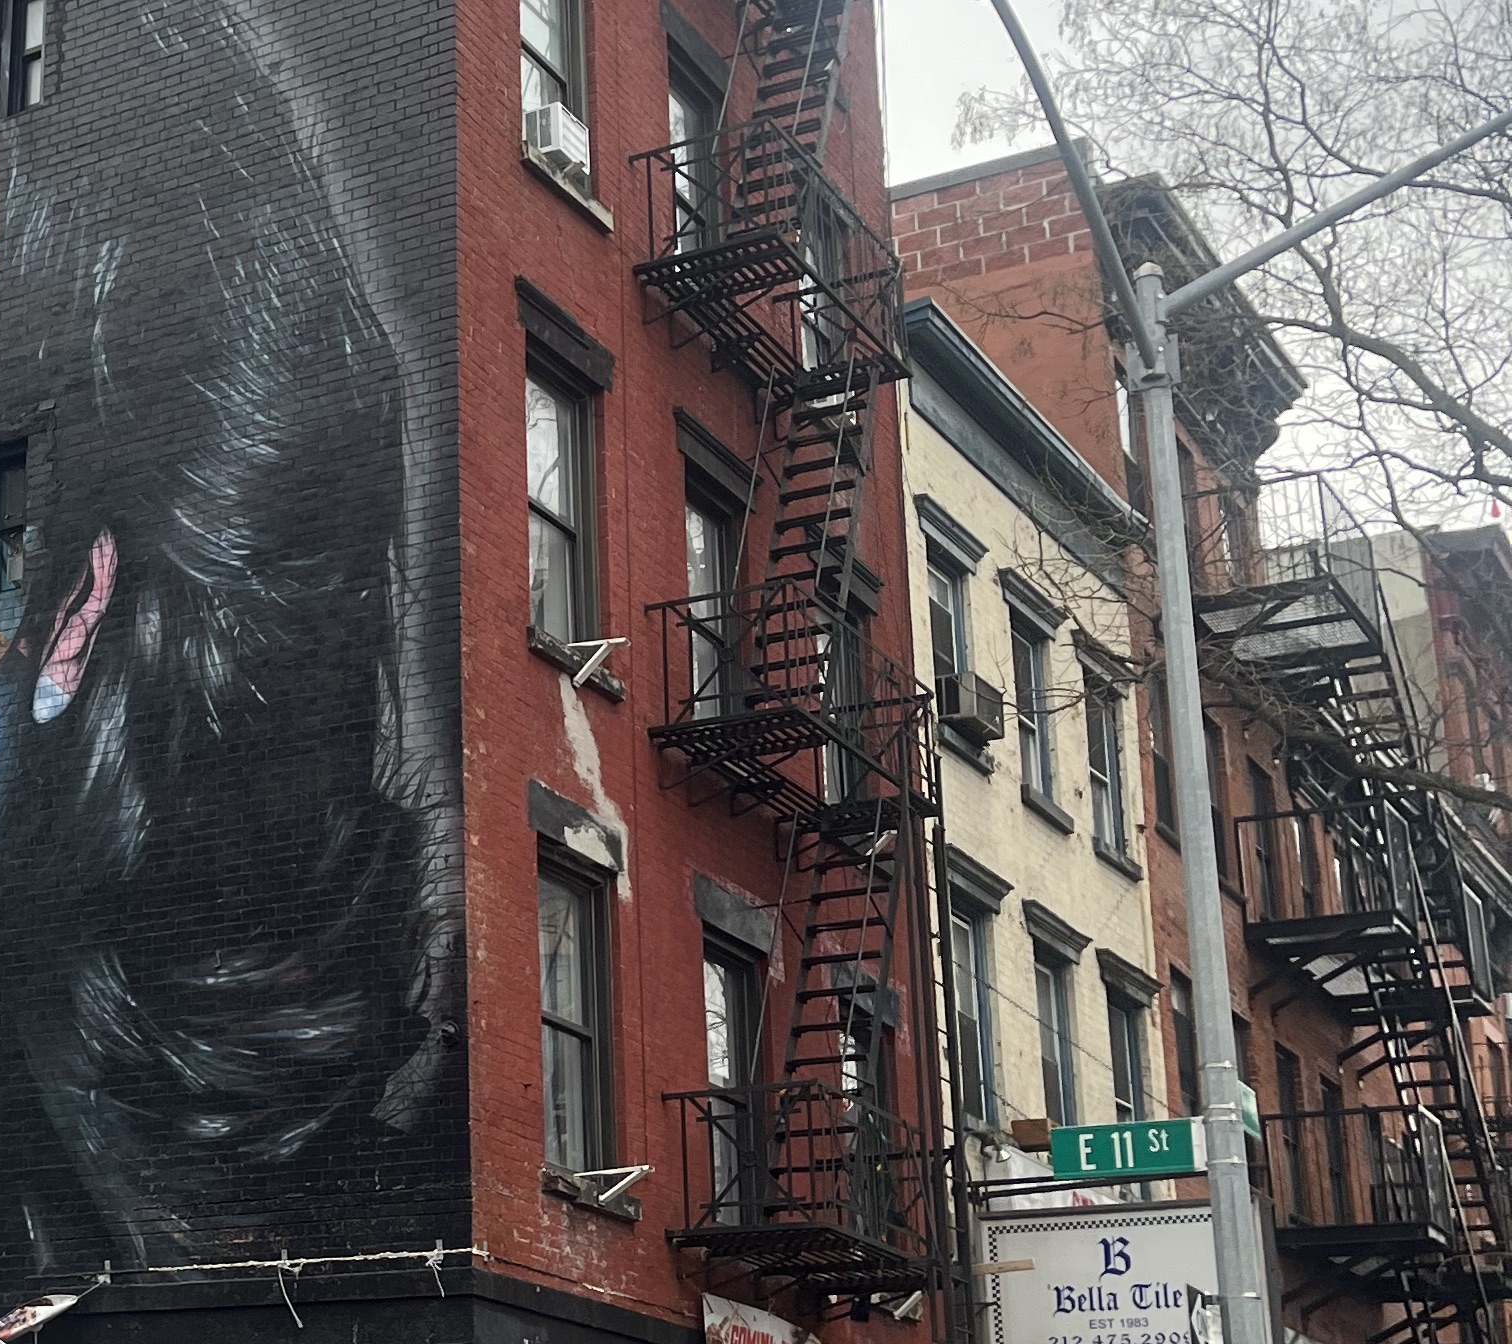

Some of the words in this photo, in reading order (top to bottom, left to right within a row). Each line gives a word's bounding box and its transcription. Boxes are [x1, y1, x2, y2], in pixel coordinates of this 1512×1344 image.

[1079, 1133, 1097, 1170] E
[1111, 1131, 1134, 1168] 11
[1148, 1128, 1170, 1152] St
[1097, 1236, 1132, 1281] B
[1052, 1284, 1119, 1317] Bella
[1129, 1282, 1183, 1310] Tile
[1089, 1318, 1114, 1329] EST
[1120, 1317, 1149, 1328] 1983
